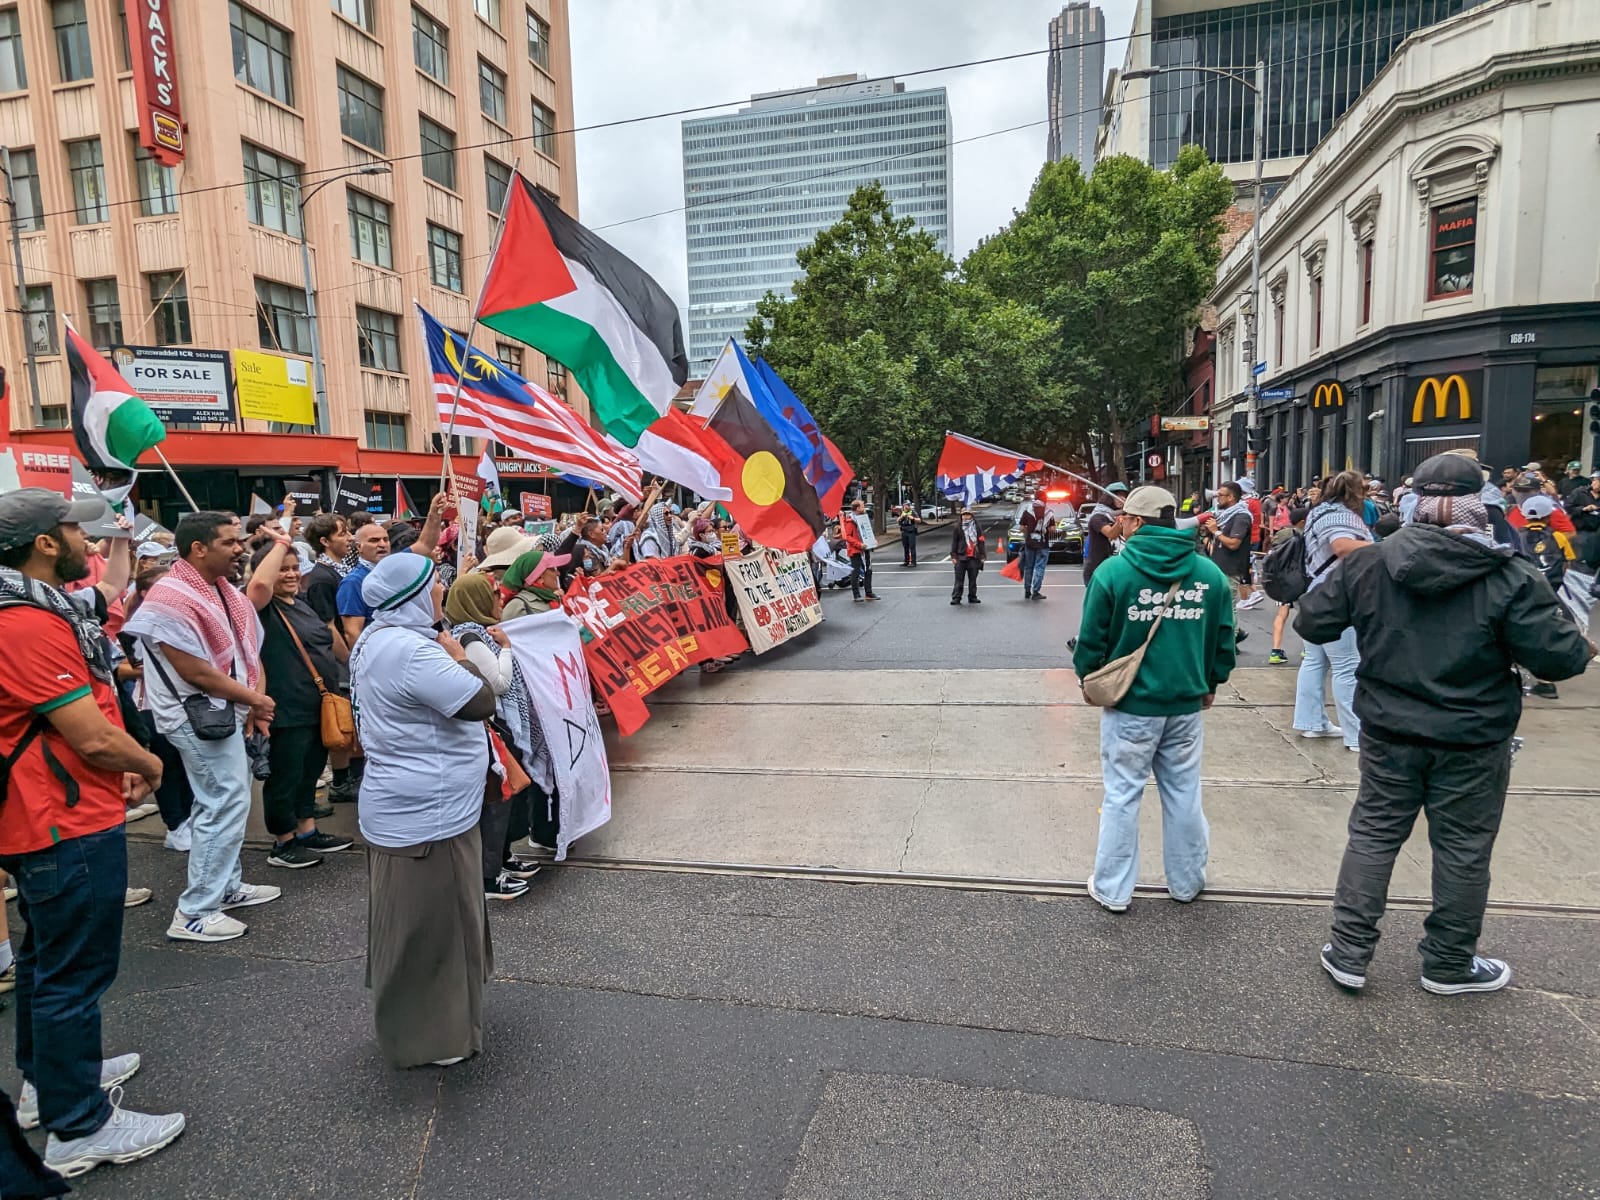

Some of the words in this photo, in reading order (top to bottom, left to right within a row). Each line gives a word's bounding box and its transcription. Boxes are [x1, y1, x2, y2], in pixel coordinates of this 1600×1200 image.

[1438, 217, 1474, 233] MAFIA
[135, 367, 168, 379] FOR
[172, 368, 212, 380] SALE
[241, 361, 262, 375] Sale
[22, 452, 71, 469] FREE
[24, 465, 70, 475] PALESTINE
[738, 560, 764, 583] FROM
[602, 575, 639, 600] THE
[744, 587, 760, 605] TO
[756, 582, 775, 602] THE
[1138, 588, 1204, 605] Secret
[769, 598, 789, 620] THE
[1127, 604, 1204, 622] Sneaker
